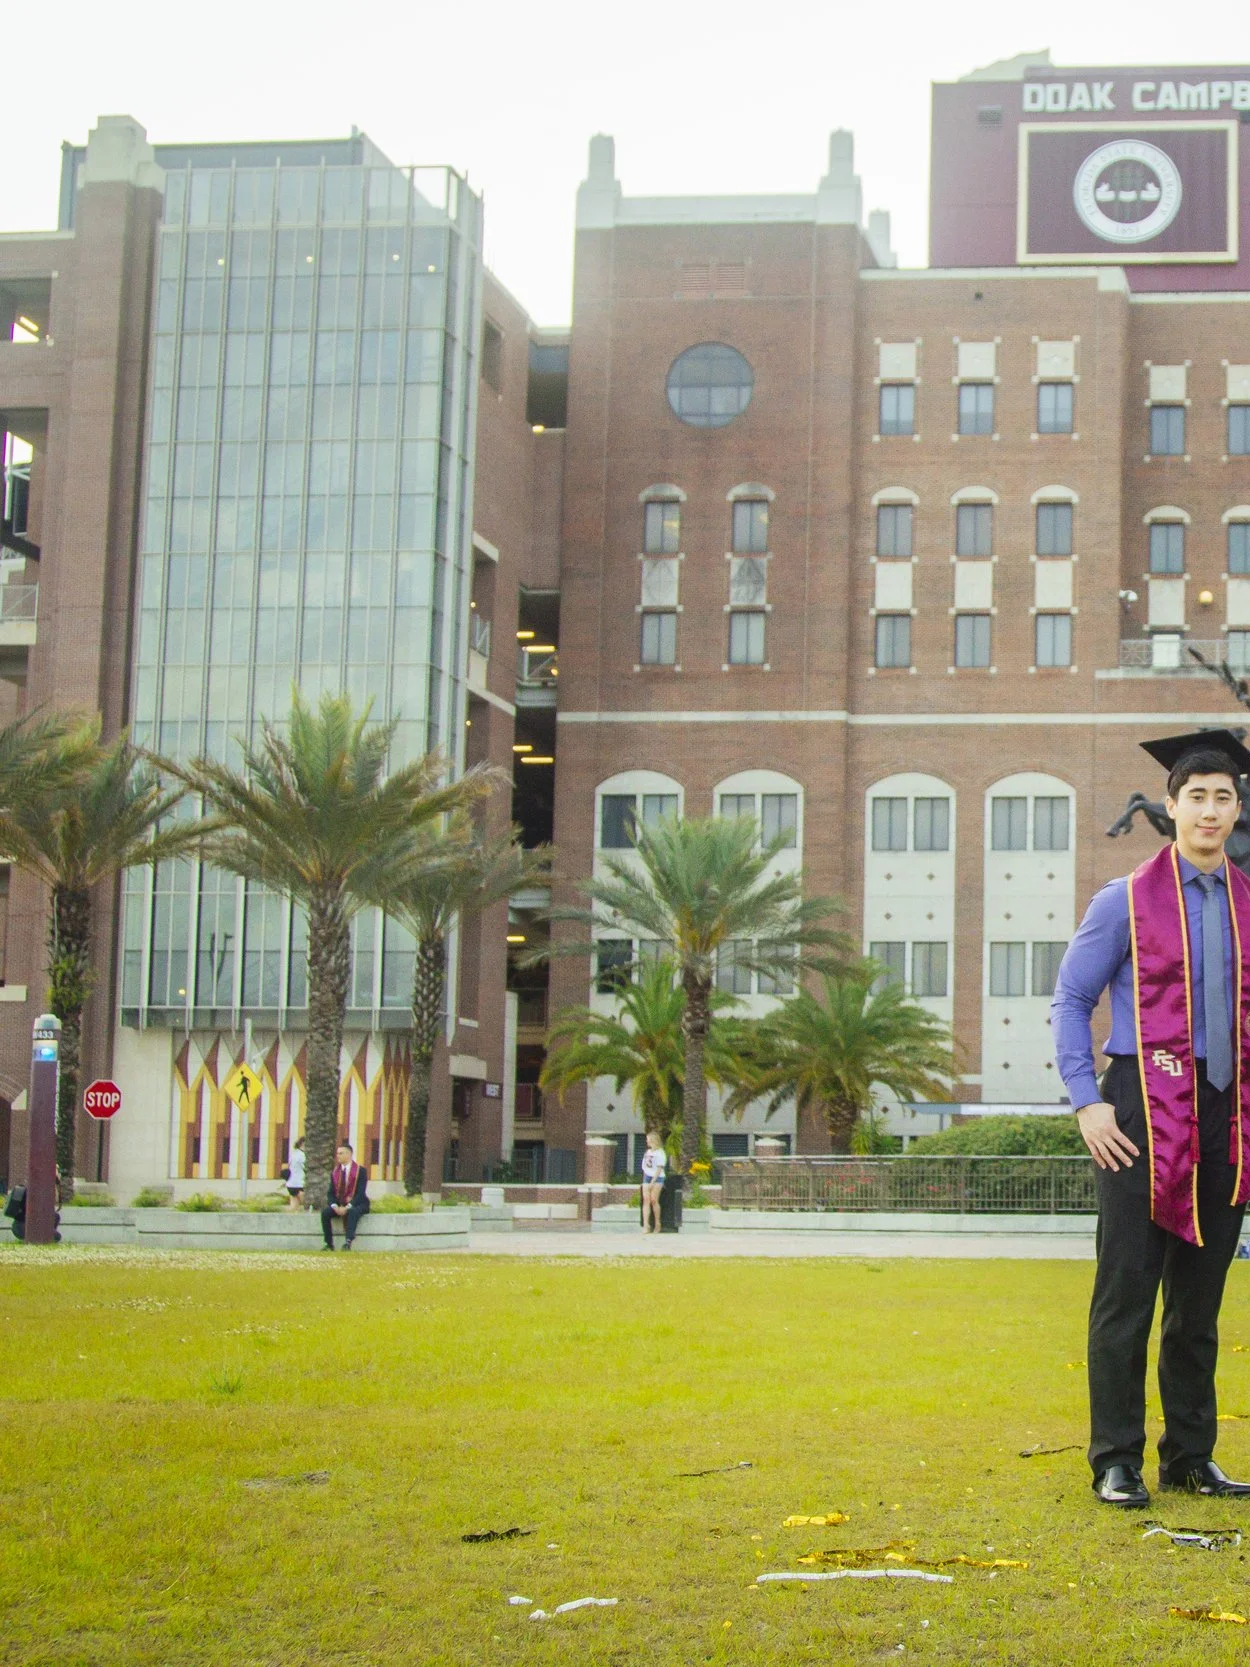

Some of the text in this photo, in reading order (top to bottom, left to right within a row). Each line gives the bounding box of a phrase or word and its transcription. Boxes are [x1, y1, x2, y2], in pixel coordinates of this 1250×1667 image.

[1022, 81, 1116, 112] DOAK
[1151, 1049, 1183, 1077] FSU
[86, 1091, 120, 1108] STOP
